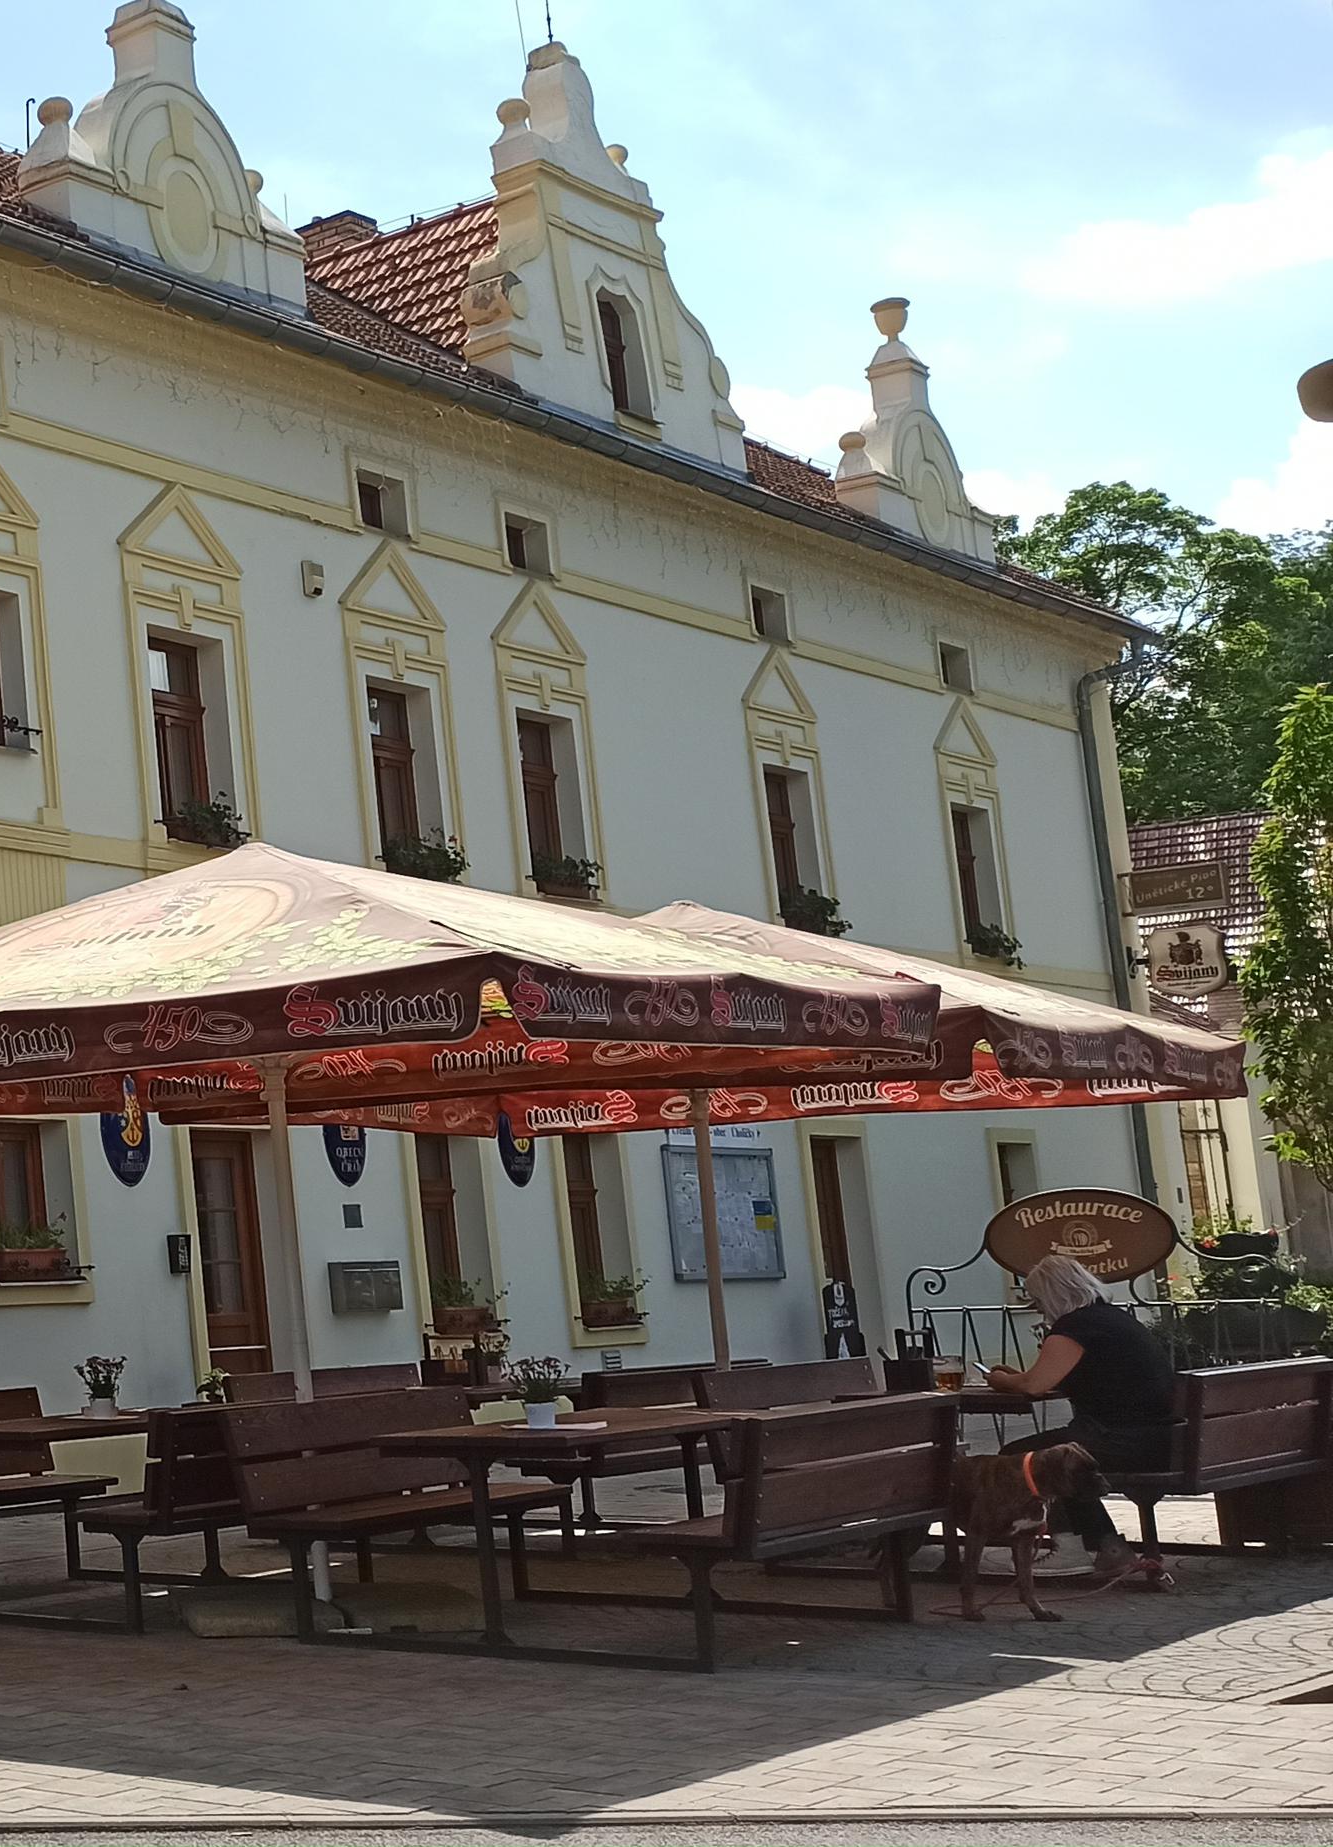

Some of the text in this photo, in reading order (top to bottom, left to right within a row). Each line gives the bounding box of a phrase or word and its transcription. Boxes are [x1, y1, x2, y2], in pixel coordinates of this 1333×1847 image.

[286, 983, 465, 1039] Svijany
[511, 964, 612, 1027] Svijany
[142, 1004, 205, 1052] 450
[1014, 1200, 1144, 1229] Restaurace
